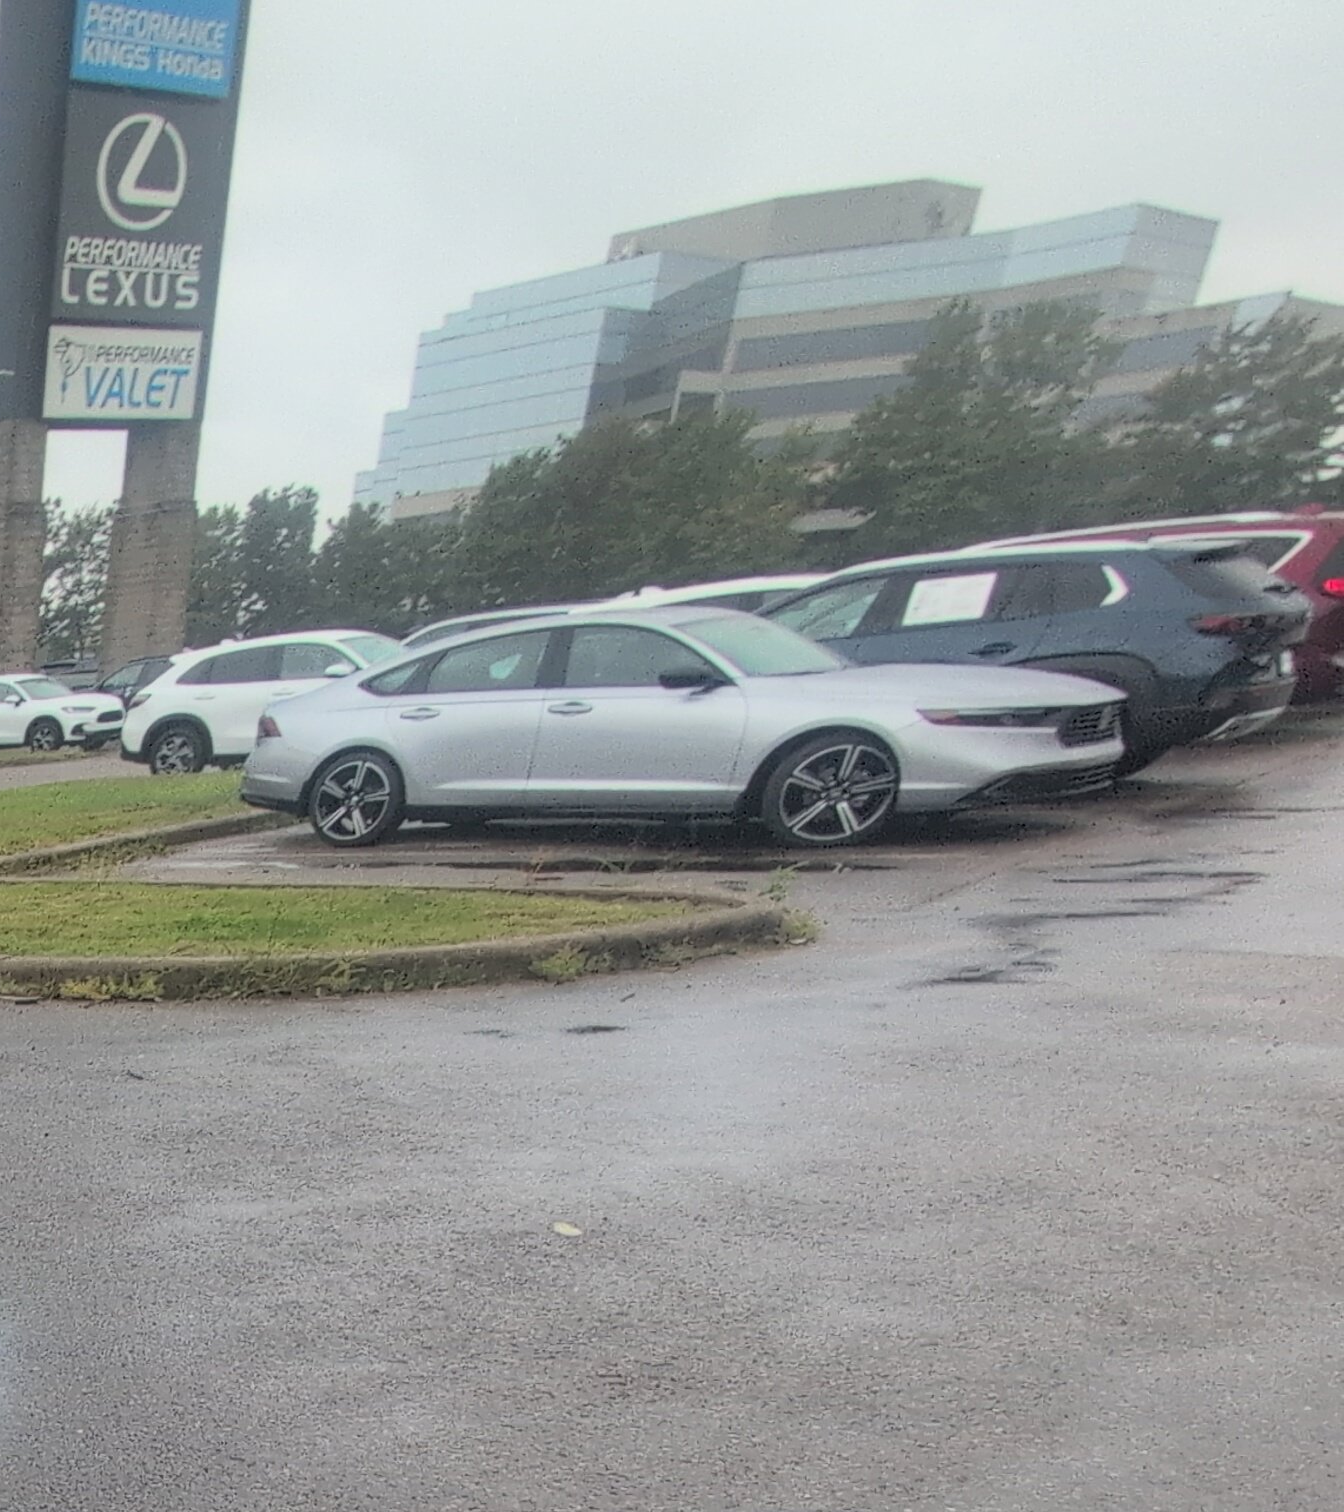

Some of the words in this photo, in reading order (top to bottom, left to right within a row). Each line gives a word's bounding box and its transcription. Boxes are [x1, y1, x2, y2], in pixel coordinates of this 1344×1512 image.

[84, 1, 230, 50] PERFORMANCE
[80, 37, 150, 71] KINGS
[64, 236, 203, 270] PERFORMANCE
[61, 267, 200, 310] LEXUS
[95, 344, 196, 365] PERFORMANCE
[85, 365, 190, 409] VALET
